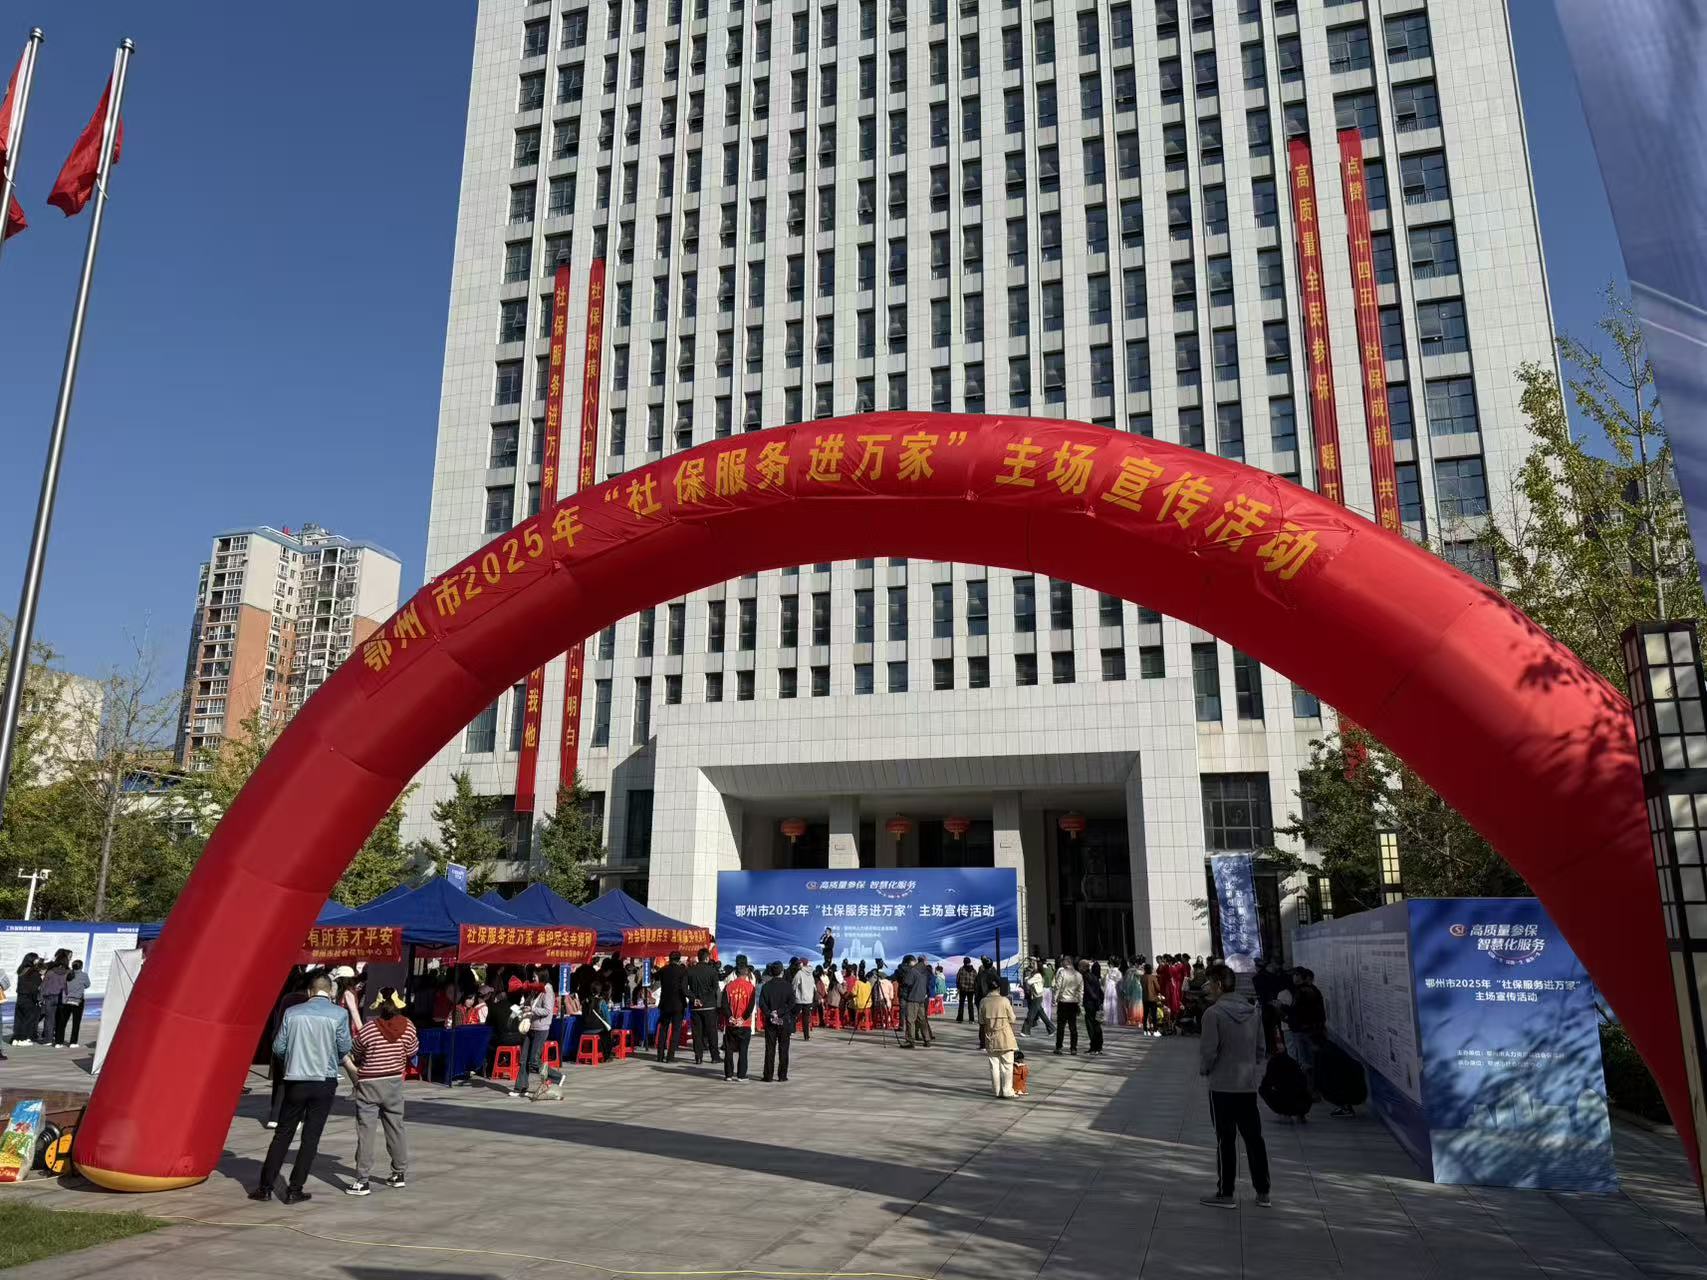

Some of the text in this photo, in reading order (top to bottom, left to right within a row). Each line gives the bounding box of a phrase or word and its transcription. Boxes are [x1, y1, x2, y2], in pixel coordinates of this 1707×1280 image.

[1295, 163, 1330, 401] 高质量全民参保
[545, 287, 567, 488] 社保服务进万家
[820, 880, 917, 890] 高质量参保 智慧化服务
[303, 926, 393, 946] 有所养才平安
[466, 927, 534, 945] 社保服务进万家
[1470, 924, 1538, 937] 高质量参保
[1478, 938, 1545, 951] 智慧化服务
[1475, 991, 1538, 1002] 主场宣传活动
